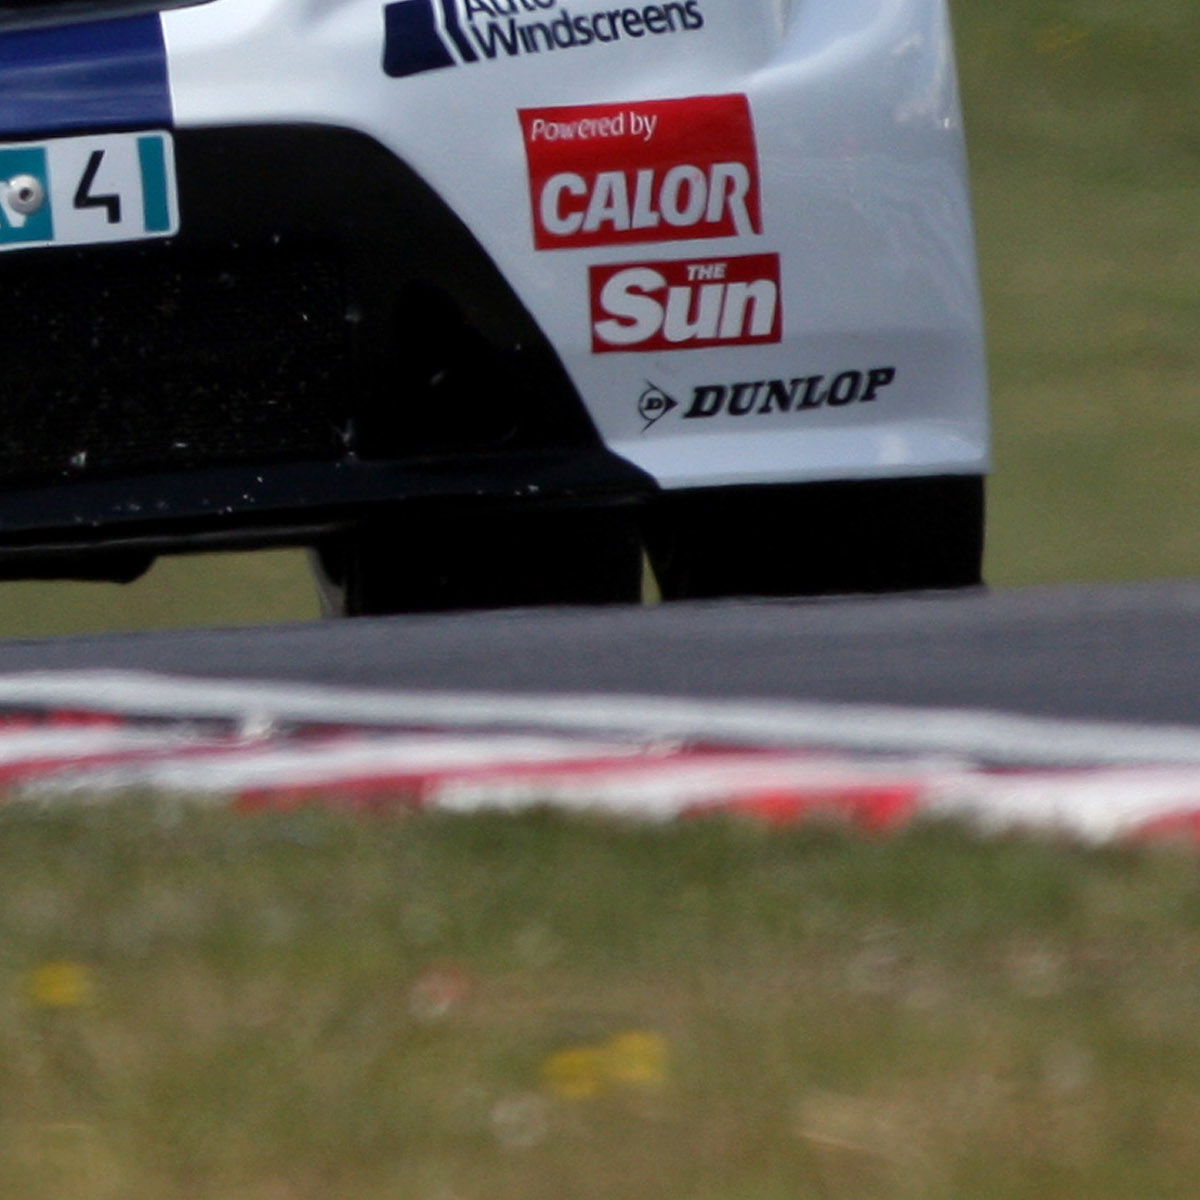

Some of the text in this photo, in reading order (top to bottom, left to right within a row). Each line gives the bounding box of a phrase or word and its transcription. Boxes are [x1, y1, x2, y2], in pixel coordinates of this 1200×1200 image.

[469, 0, 704, 60] Windscreens
[531, 111, 657, 141] Powered by
[72, 149, 122, 224] 4
[539, 162, 761, 236] CALOR
[688, 263, 727, 280] THE
[594, 266, 777, 346] Sun
[682, 367, 897, 419] DUNLOP
